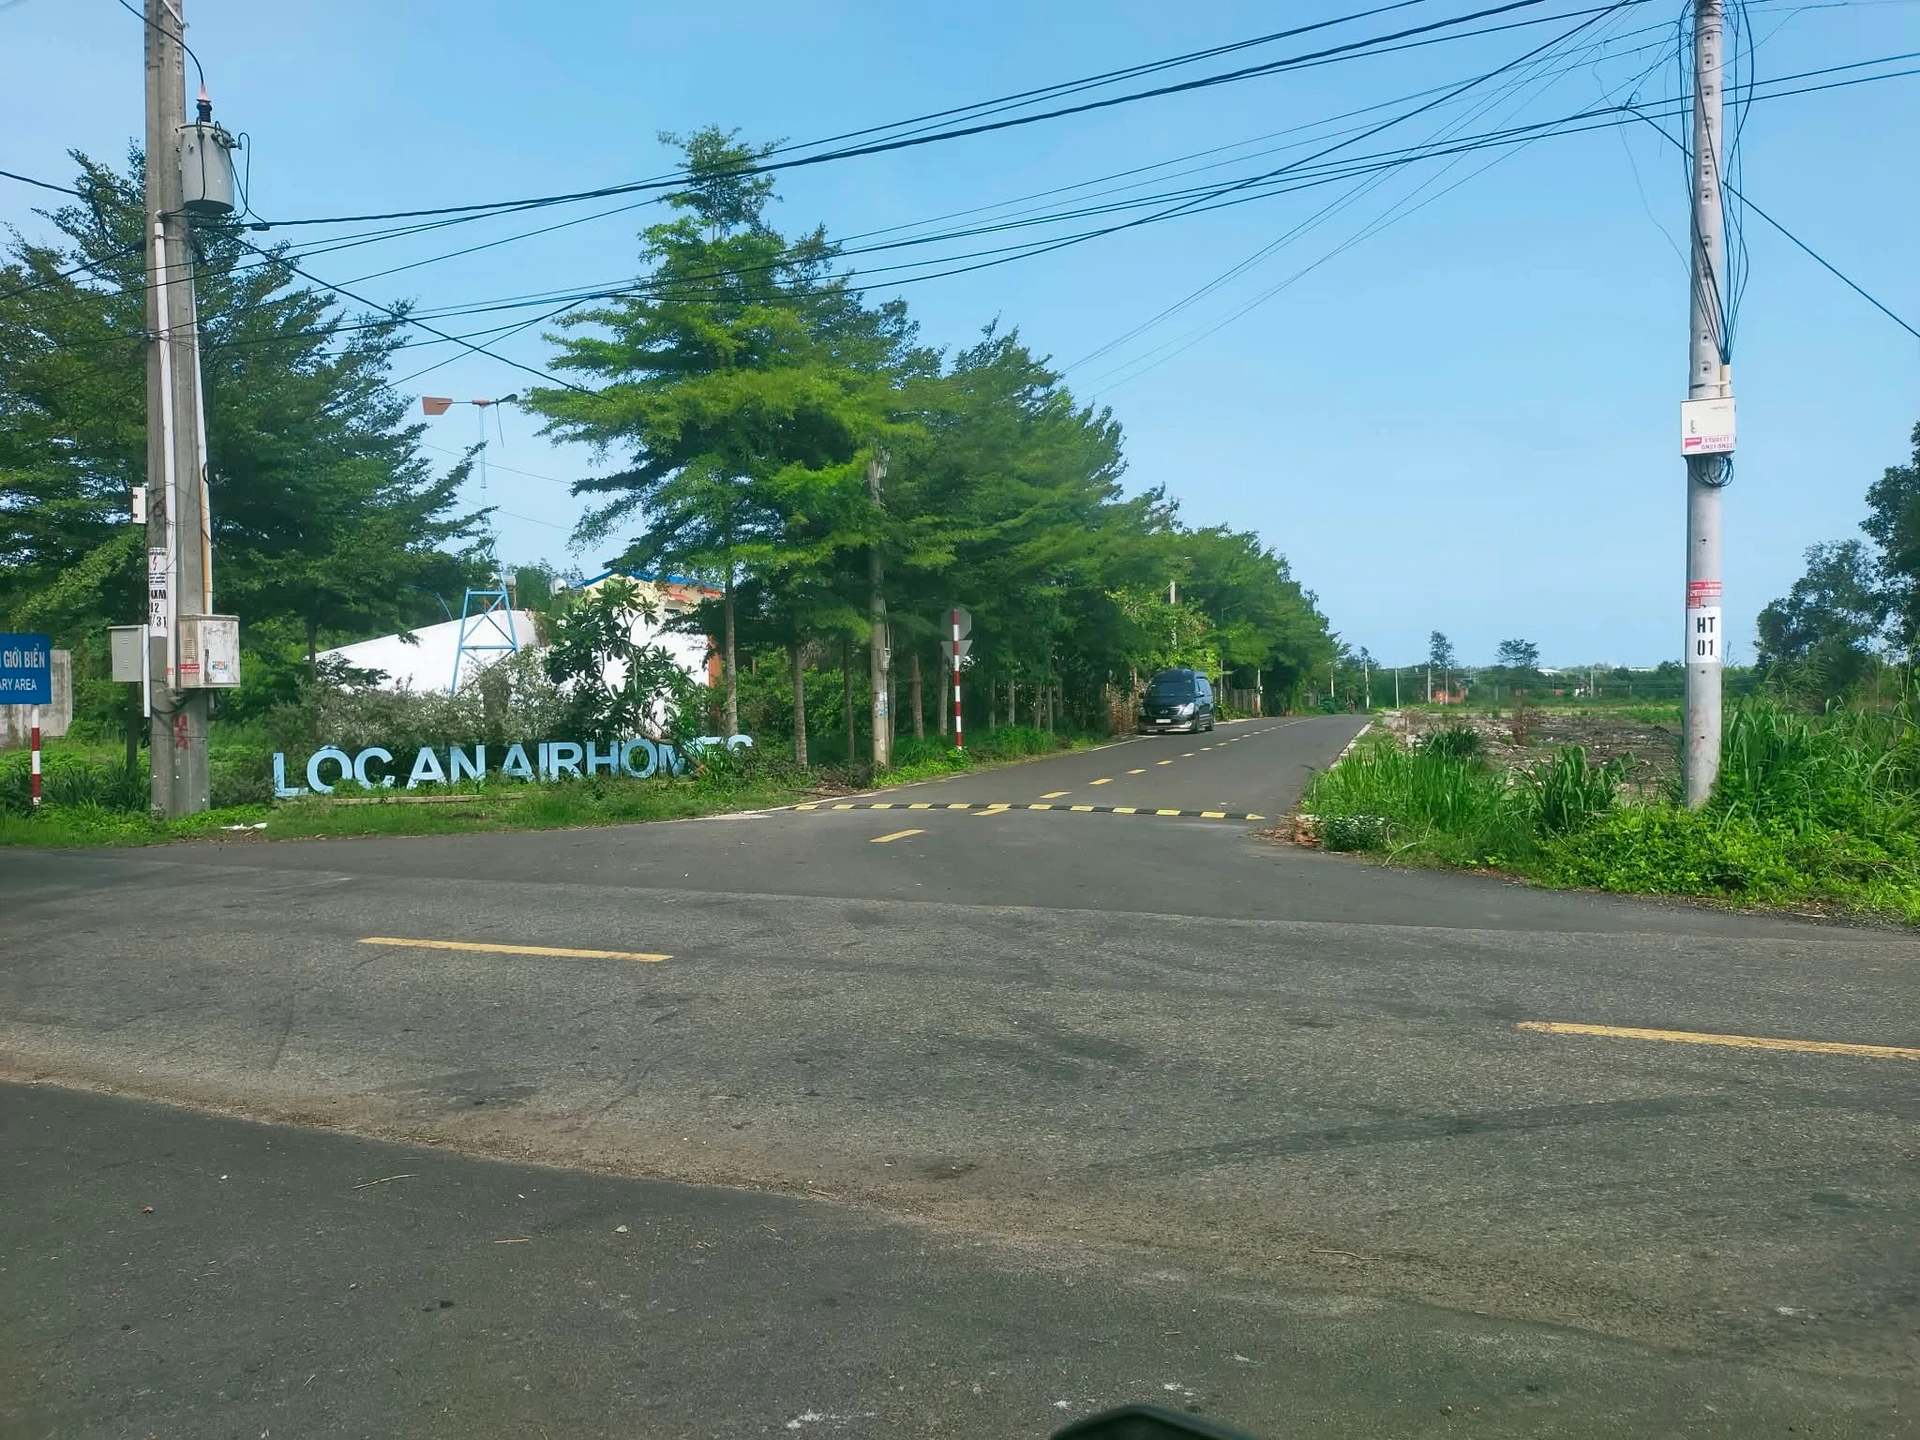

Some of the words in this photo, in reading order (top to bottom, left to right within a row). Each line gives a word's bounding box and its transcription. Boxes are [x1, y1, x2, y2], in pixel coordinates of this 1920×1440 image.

[1696, 616, 1715, 633] HT
[3, 646, 22, 668] GIỚI
[24, 643, 45, 668] BIỂN
[1697, 639, 1714, 656] 01
[14, 678, 37, 690] AREA
[406, 744, 486, 790] AN
[500, 734, 754, 782] AIRHOM
